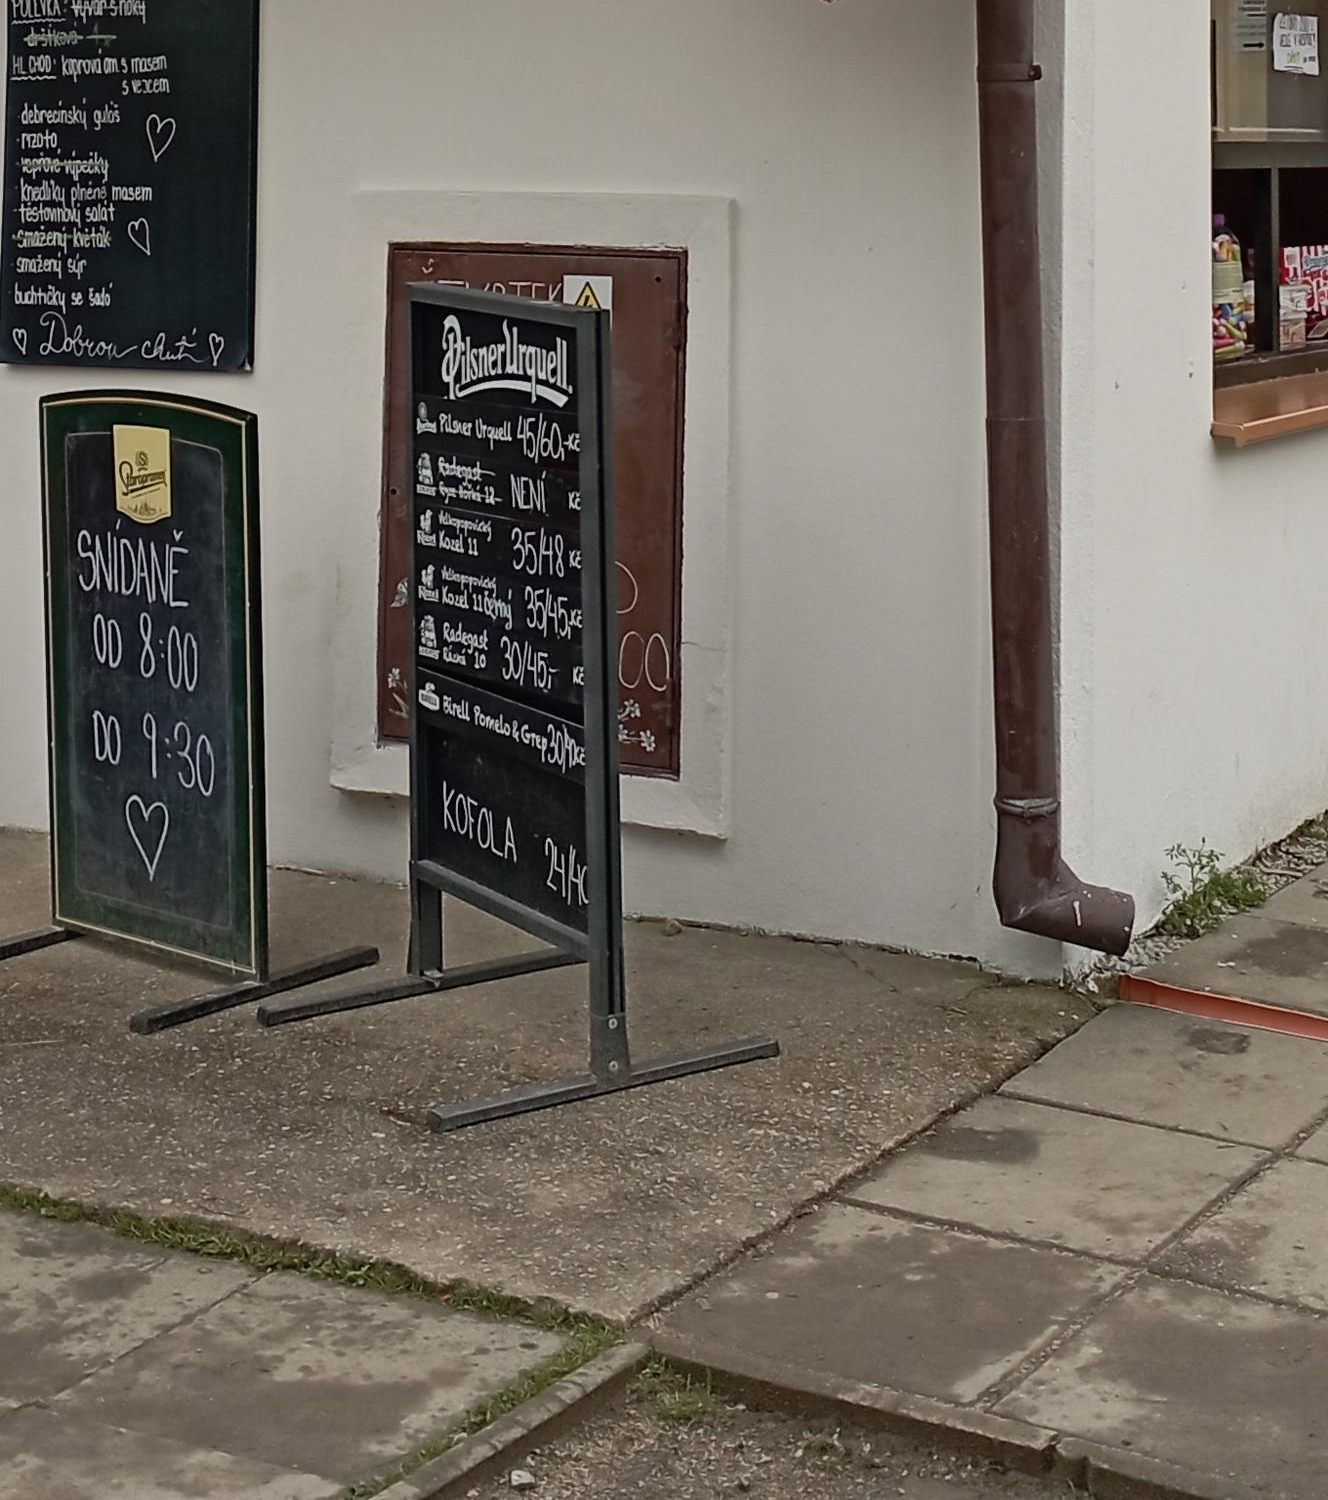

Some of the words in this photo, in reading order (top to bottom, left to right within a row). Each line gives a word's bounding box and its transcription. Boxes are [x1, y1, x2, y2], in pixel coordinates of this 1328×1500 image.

[131, 55, 168, 73] masem
[121, 79, 129, 96] s
[21, 130, 58, 150] rizoto
[112, 185, 153, 201] masem
[16, 252, 63, 279] smažený
[67, 253, 87, 280] sýr
[71, 291, 84, 306] se
[39, 311, 138, 360] Dobrou
[441, 314, 506, 401] Pilsner
[439, 413, 472, 437] Pilsner
[475, 417, 513, 450] Urquell
[568, 433, 581, 452] Kč
[509, 470, 547, 514] NENÍ
[568, 491, 582, 511] Kč
[76, 519, 189, 608] SNÍDANĚ
[438, 530, 465, 554] Kozel
[467, 537, 479, 557] 11
[510, 526, 565, 578] 35/48
[568, 550, 582, 569] Kč
[441, 585, 470, 610] Kozel
[472, 592, 484, 614] 11
[570, 609, 583, 629] Kč
[93, 613, 122, 669] OD
[139, 612, 199, 692] 8:00
[442, 622, 489, 654] Radegast
[474, 651, 487, 669] 10
[572, 666, 585, 686] Kč
[92, 710, 121, 765] DO
[142, 712, 215, 797] 9:30
[473, 705, 511, 737] Pomelo
[512, 720, 520, 743] &
[521, 725, 548, 763] Grep
[441, 780, 518, 863] KOFOLA
